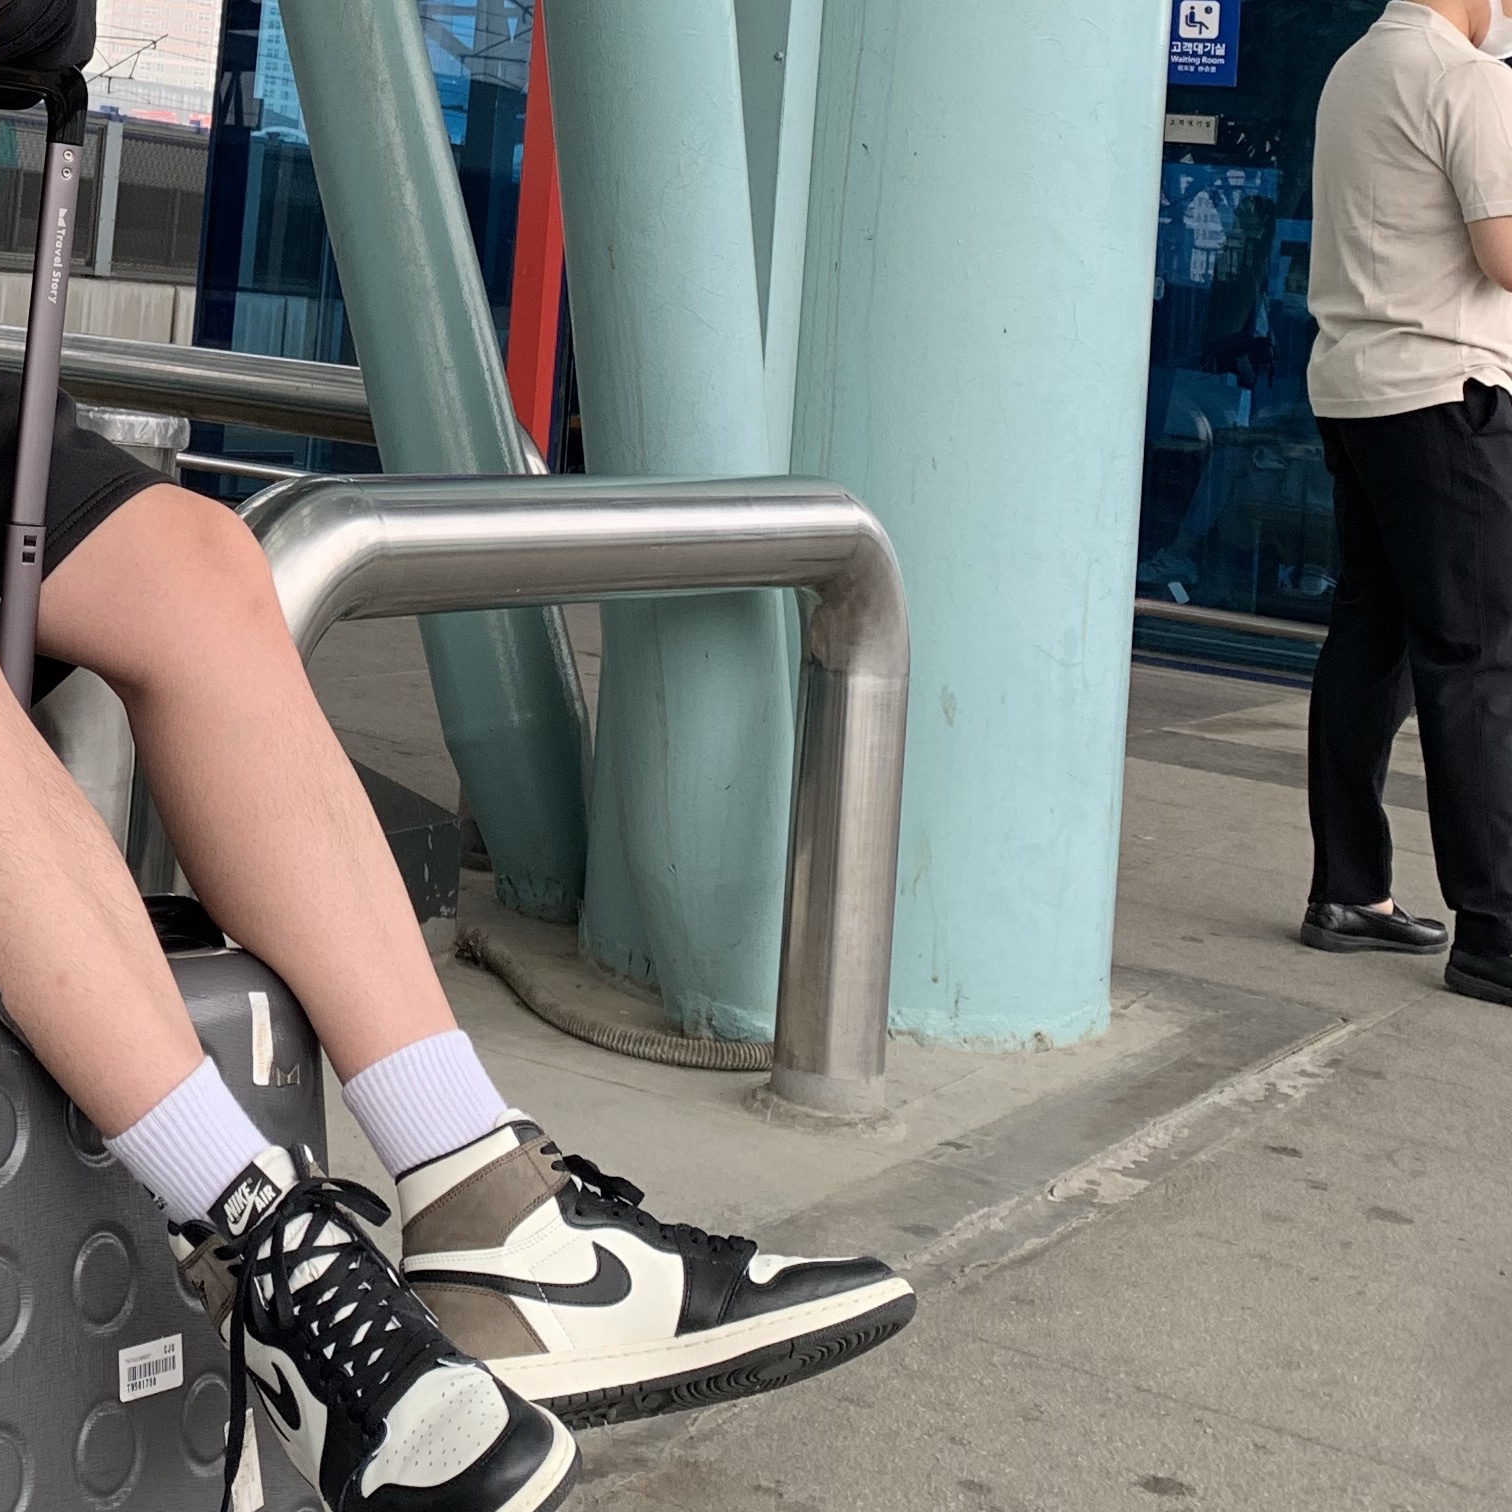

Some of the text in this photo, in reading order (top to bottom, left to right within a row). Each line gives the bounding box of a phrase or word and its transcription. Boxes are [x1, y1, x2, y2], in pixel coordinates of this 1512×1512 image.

[1170, 41, 1226, 56] 고객대기실
[1170, 55, 1225, 66] Waiting Room
[47, 228, 66, 304] Travel Story
[223, 1181, 250, 1222] NIKE
[254, 1184, 277, 1213] AIR
